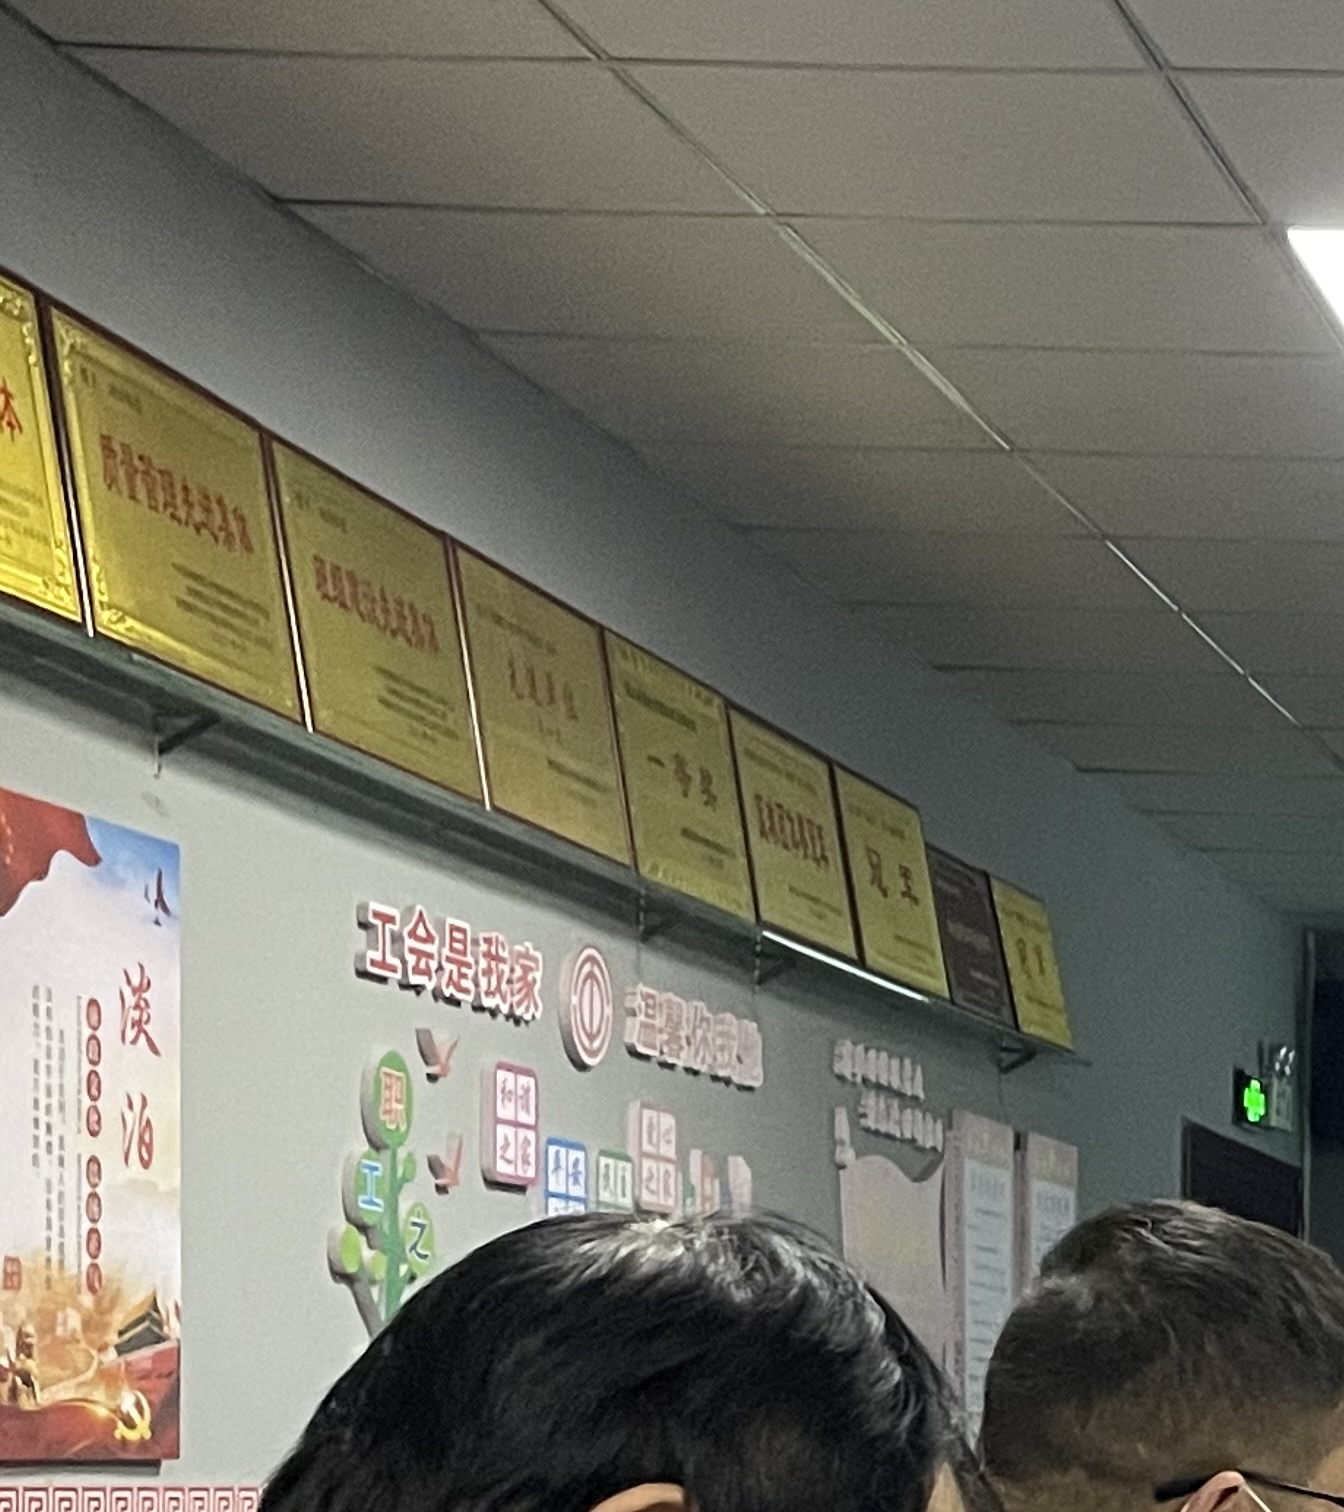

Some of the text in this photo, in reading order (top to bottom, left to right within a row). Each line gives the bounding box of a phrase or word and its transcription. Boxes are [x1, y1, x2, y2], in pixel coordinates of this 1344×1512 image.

[366, 902, 543, 1020] 工会是我家
